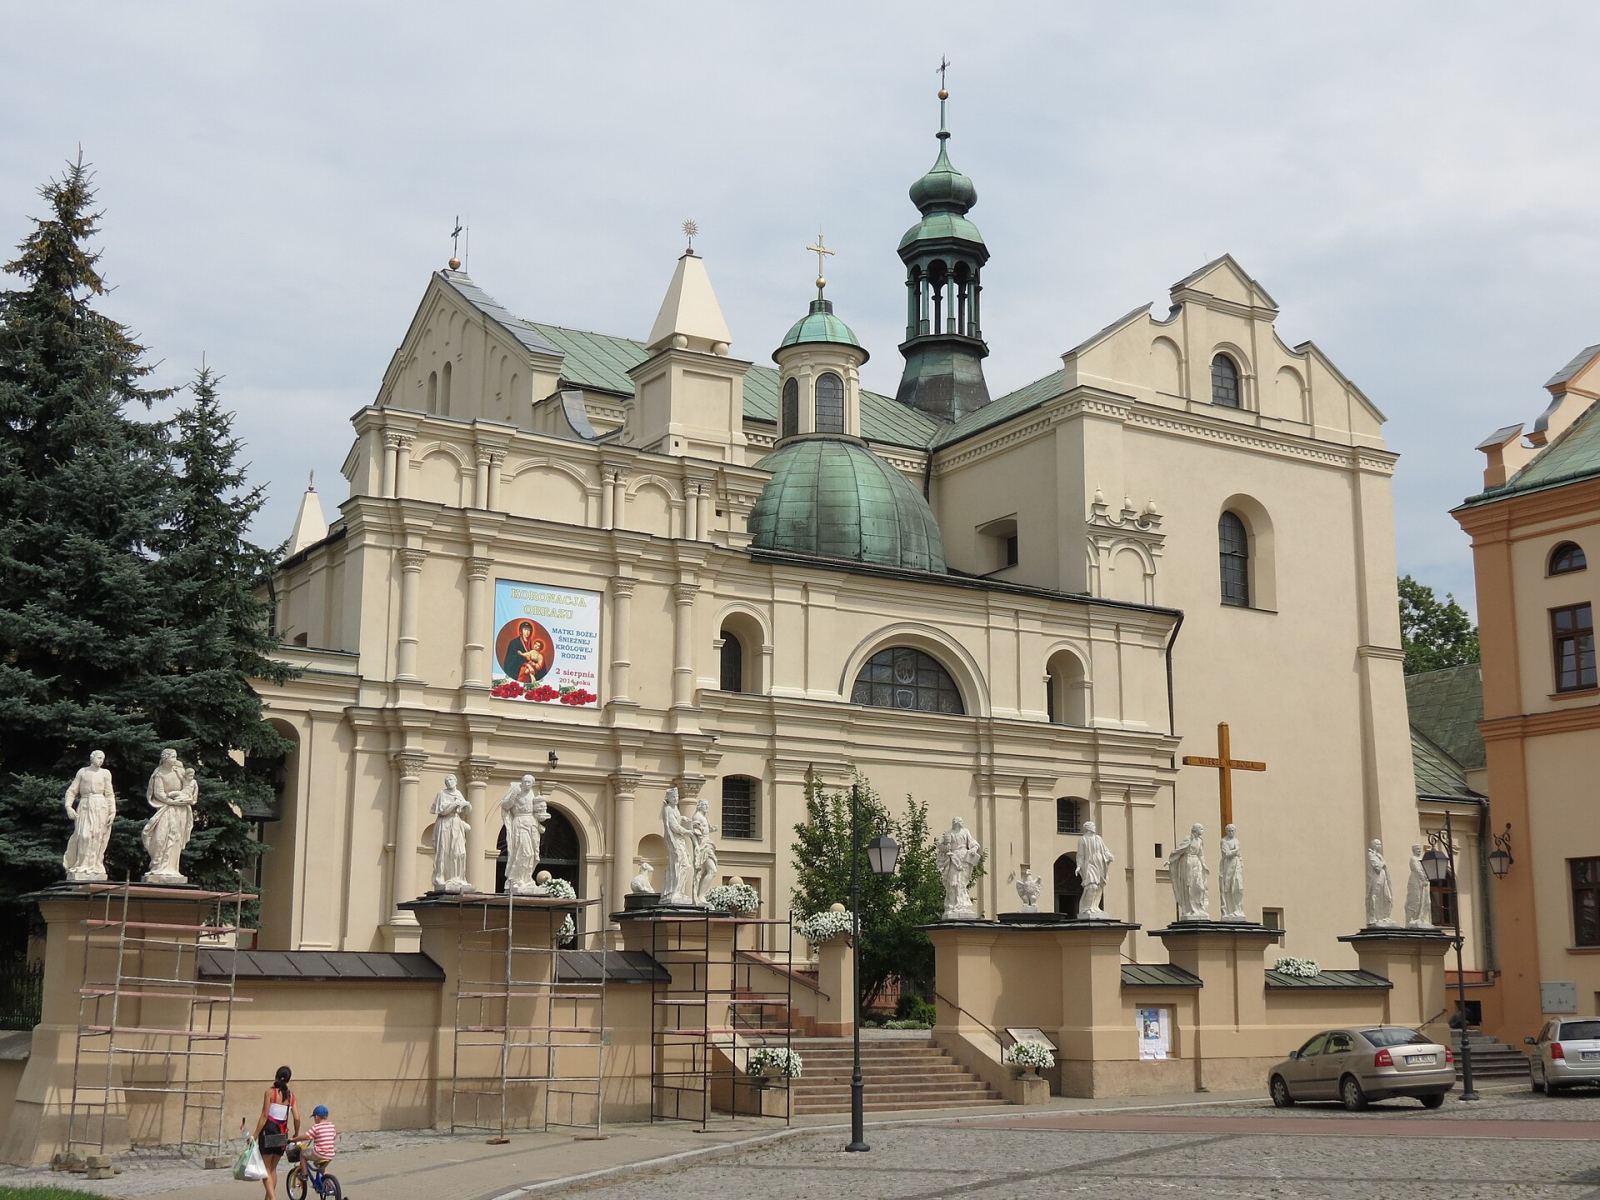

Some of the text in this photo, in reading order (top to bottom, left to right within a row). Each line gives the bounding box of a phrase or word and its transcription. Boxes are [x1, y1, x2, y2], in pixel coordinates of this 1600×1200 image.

[551, 627, 574, 636] MATKI
[561, 652, 587, 661] RODZIN
[555, 667, 595, 679] 2 sierpnia
